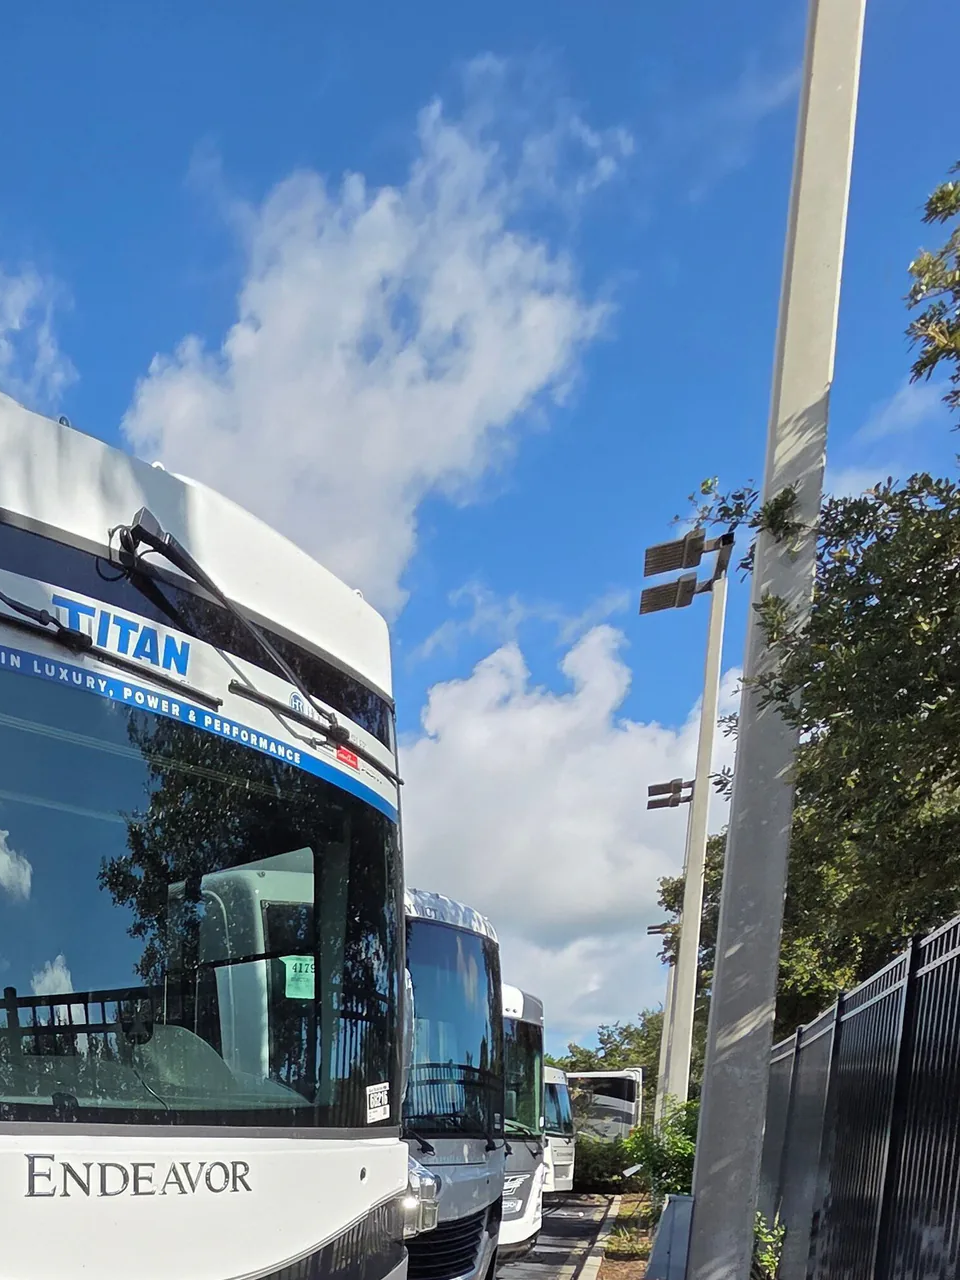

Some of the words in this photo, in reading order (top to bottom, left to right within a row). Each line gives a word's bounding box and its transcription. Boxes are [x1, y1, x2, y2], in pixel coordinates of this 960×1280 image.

[51, 594, 190, 677] TITAN
[0, 653, 21, 669] IN
[33, 660, 114, 697] LUXURY,
[123, 687, 180, 717] POWER
[188, 709, 197, 723] &
[204, 715, 302, 764] PERFORMANCE
[24, 1153, 253, 1198] ENDEAVOR
